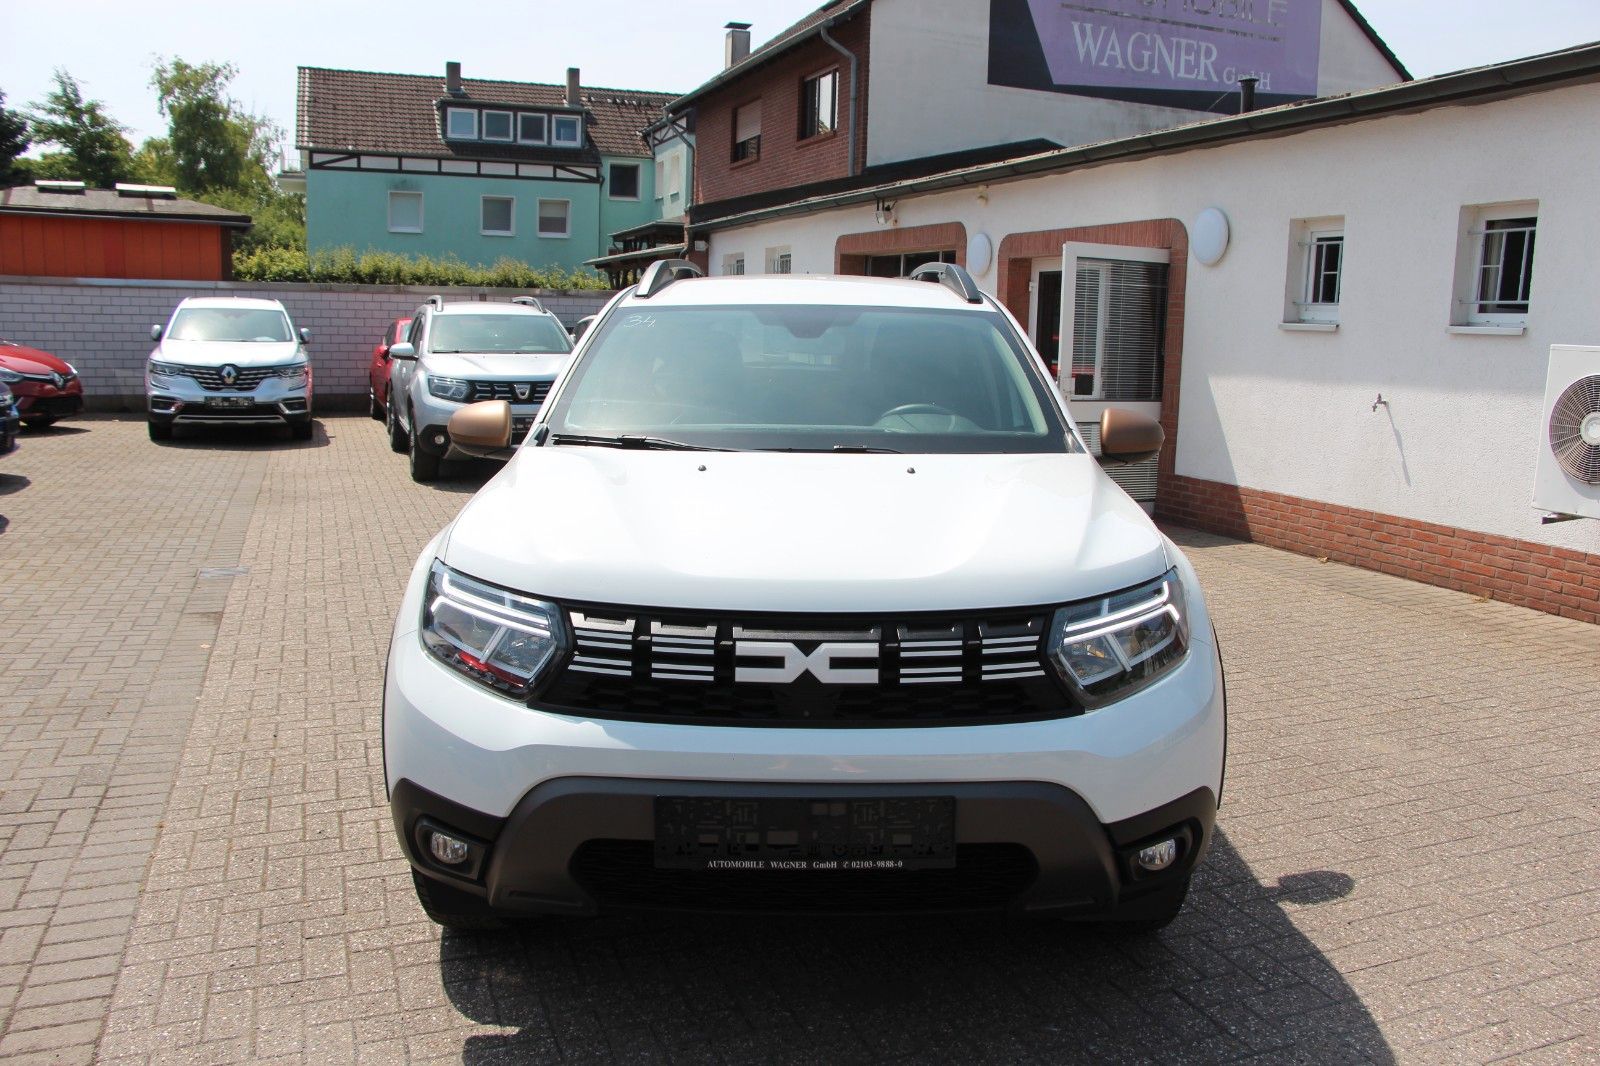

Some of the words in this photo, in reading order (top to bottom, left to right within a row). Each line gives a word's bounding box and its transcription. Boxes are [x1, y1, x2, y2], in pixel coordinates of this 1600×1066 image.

[1071, 21, 1219, 83] WAGNER
[707, 860, 765, 869] AUTOMOBILE
[770, 861, 807, 869] WAGNER
[813, 861, 837, 869] GmbH
